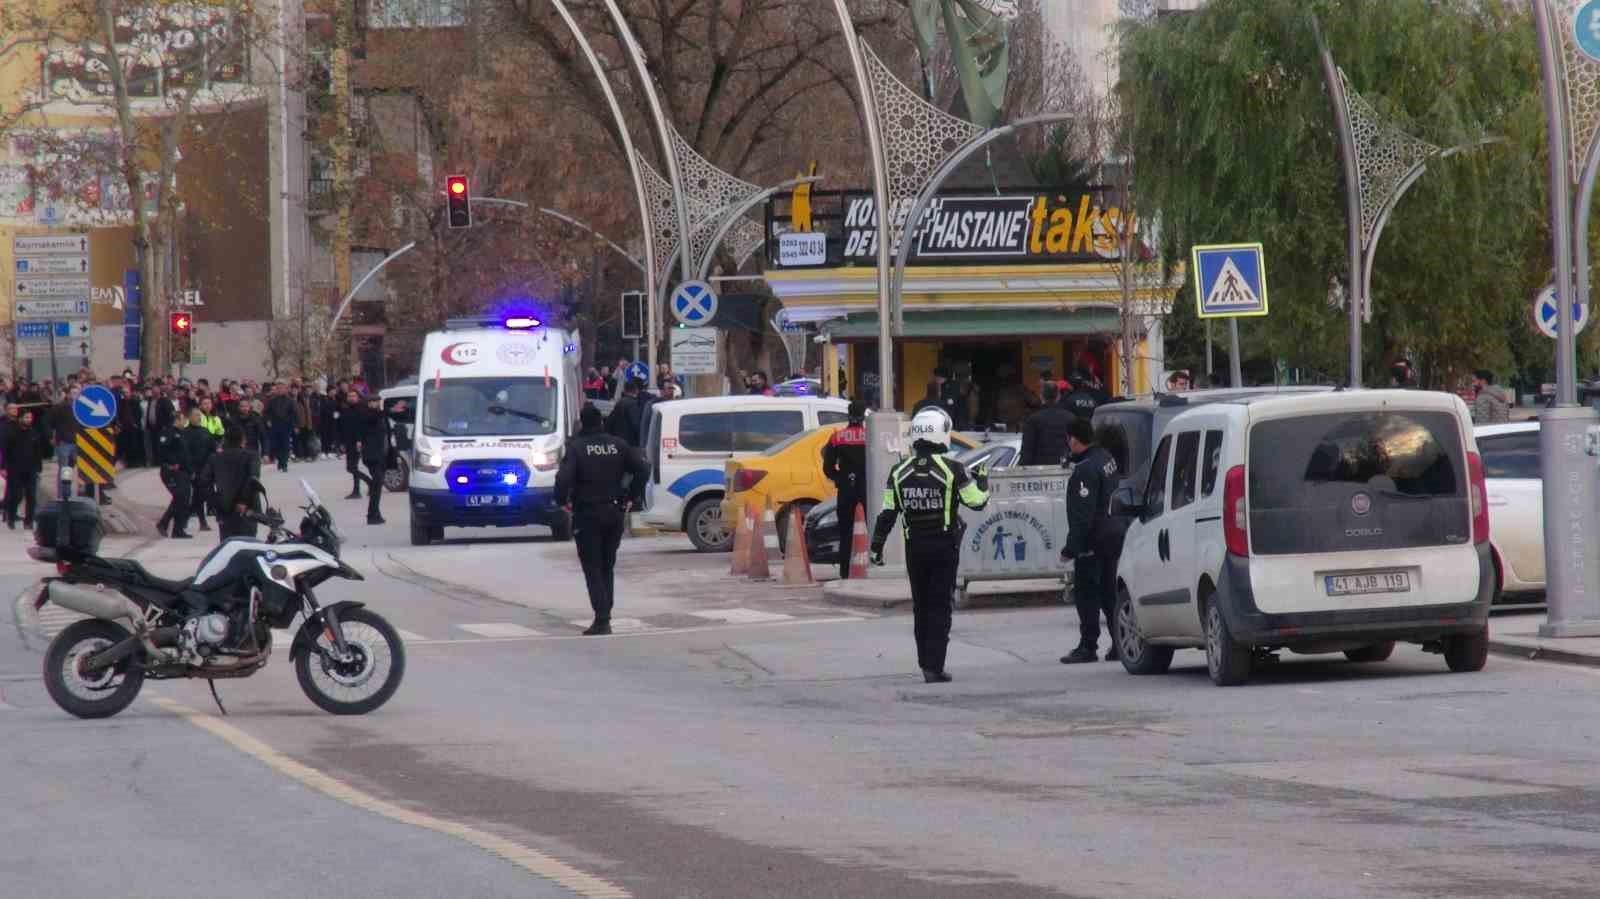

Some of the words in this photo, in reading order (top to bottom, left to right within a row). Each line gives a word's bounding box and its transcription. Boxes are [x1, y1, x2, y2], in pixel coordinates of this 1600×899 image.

[928, 210, 1024, 249] HASTANE
[1336, 576, 1348, 590] 41
[1384, 574, 1404, 589] 119
